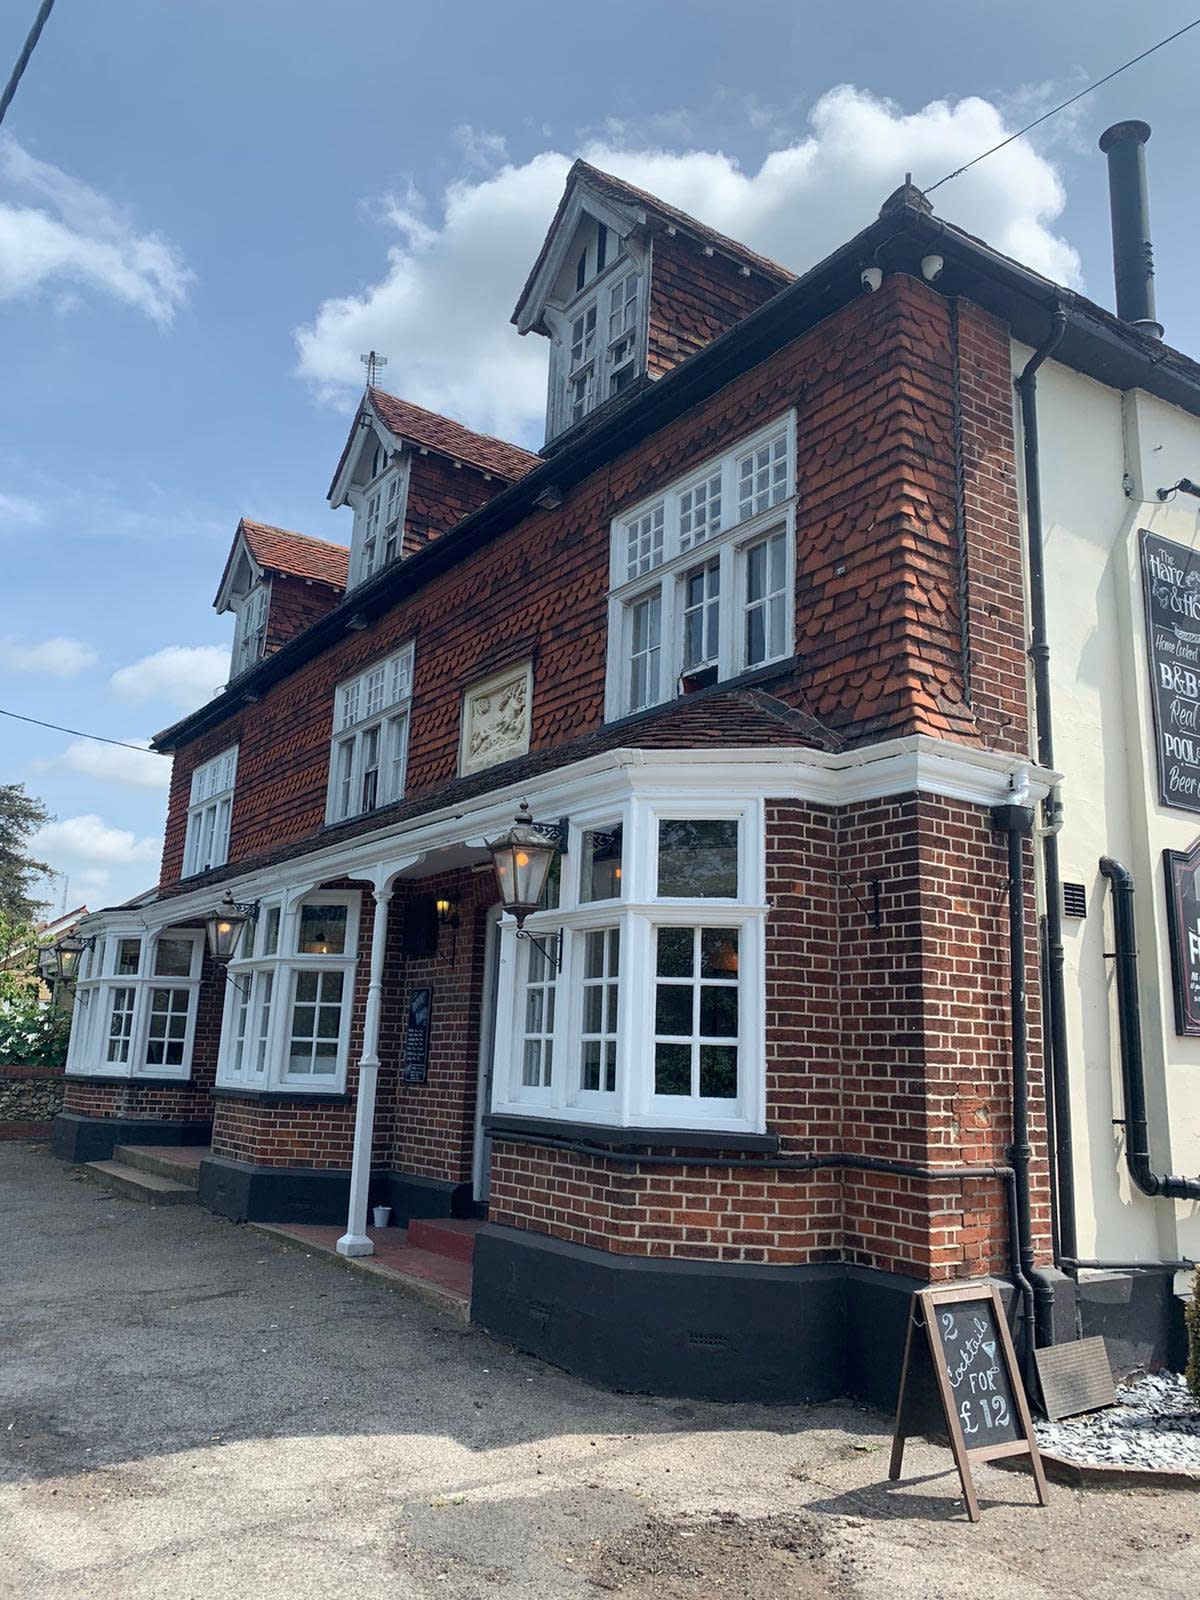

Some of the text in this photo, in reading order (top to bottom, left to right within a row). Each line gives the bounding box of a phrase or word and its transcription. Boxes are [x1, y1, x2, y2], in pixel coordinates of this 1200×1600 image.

[1149, 554, 1186, 588] Hare
[1158, 548, 1175, 566] The
[1155, 634, 1176, 657] Home
[1175, 640, 1199, 663] Cooked
[1169, 699, 1197, 731] Real
[1164, 732, 1198, 765] POOL
[1169, 765, 1197, 794] Beer
[941, 1313, 958, 1341] 2
[947, 1317, 989, 1388] Cocktails
[969, 1370, 997, 1394] FOR
